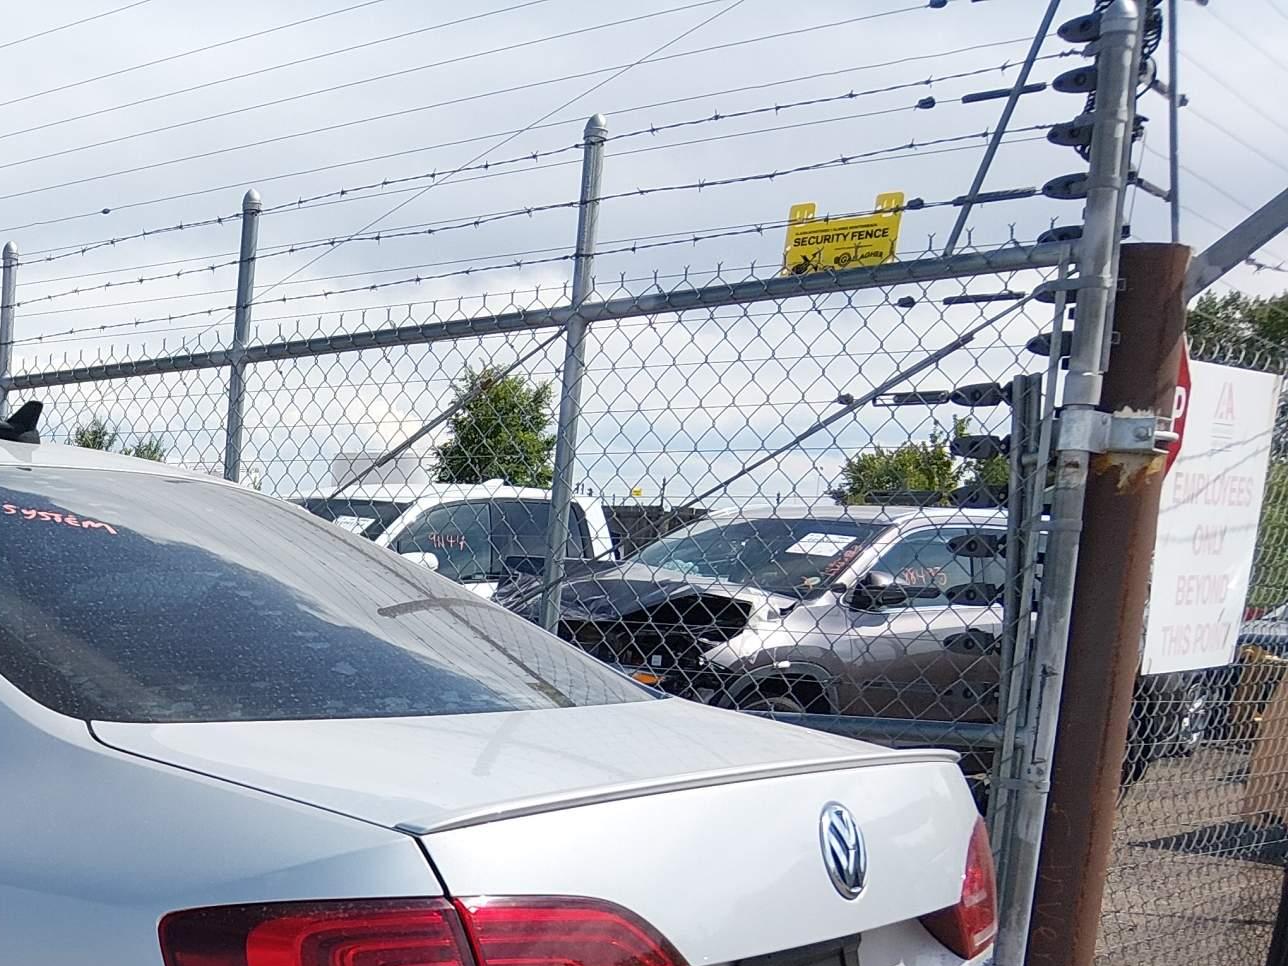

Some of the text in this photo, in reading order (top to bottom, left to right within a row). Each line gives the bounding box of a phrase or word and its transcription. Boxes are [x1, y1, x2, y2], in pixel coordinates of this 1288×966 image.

[793, 232, 848, 248] SECURITY
[850, 227, 890, 241] FENCE
[1172, 471, 1255, 508] EMPLOYEES
[1191, 523, 1227, 556] ONLY
[1175, 573, 1230, 606] BEYOND
[1161, 622, 1231, 658] THIS POINT
